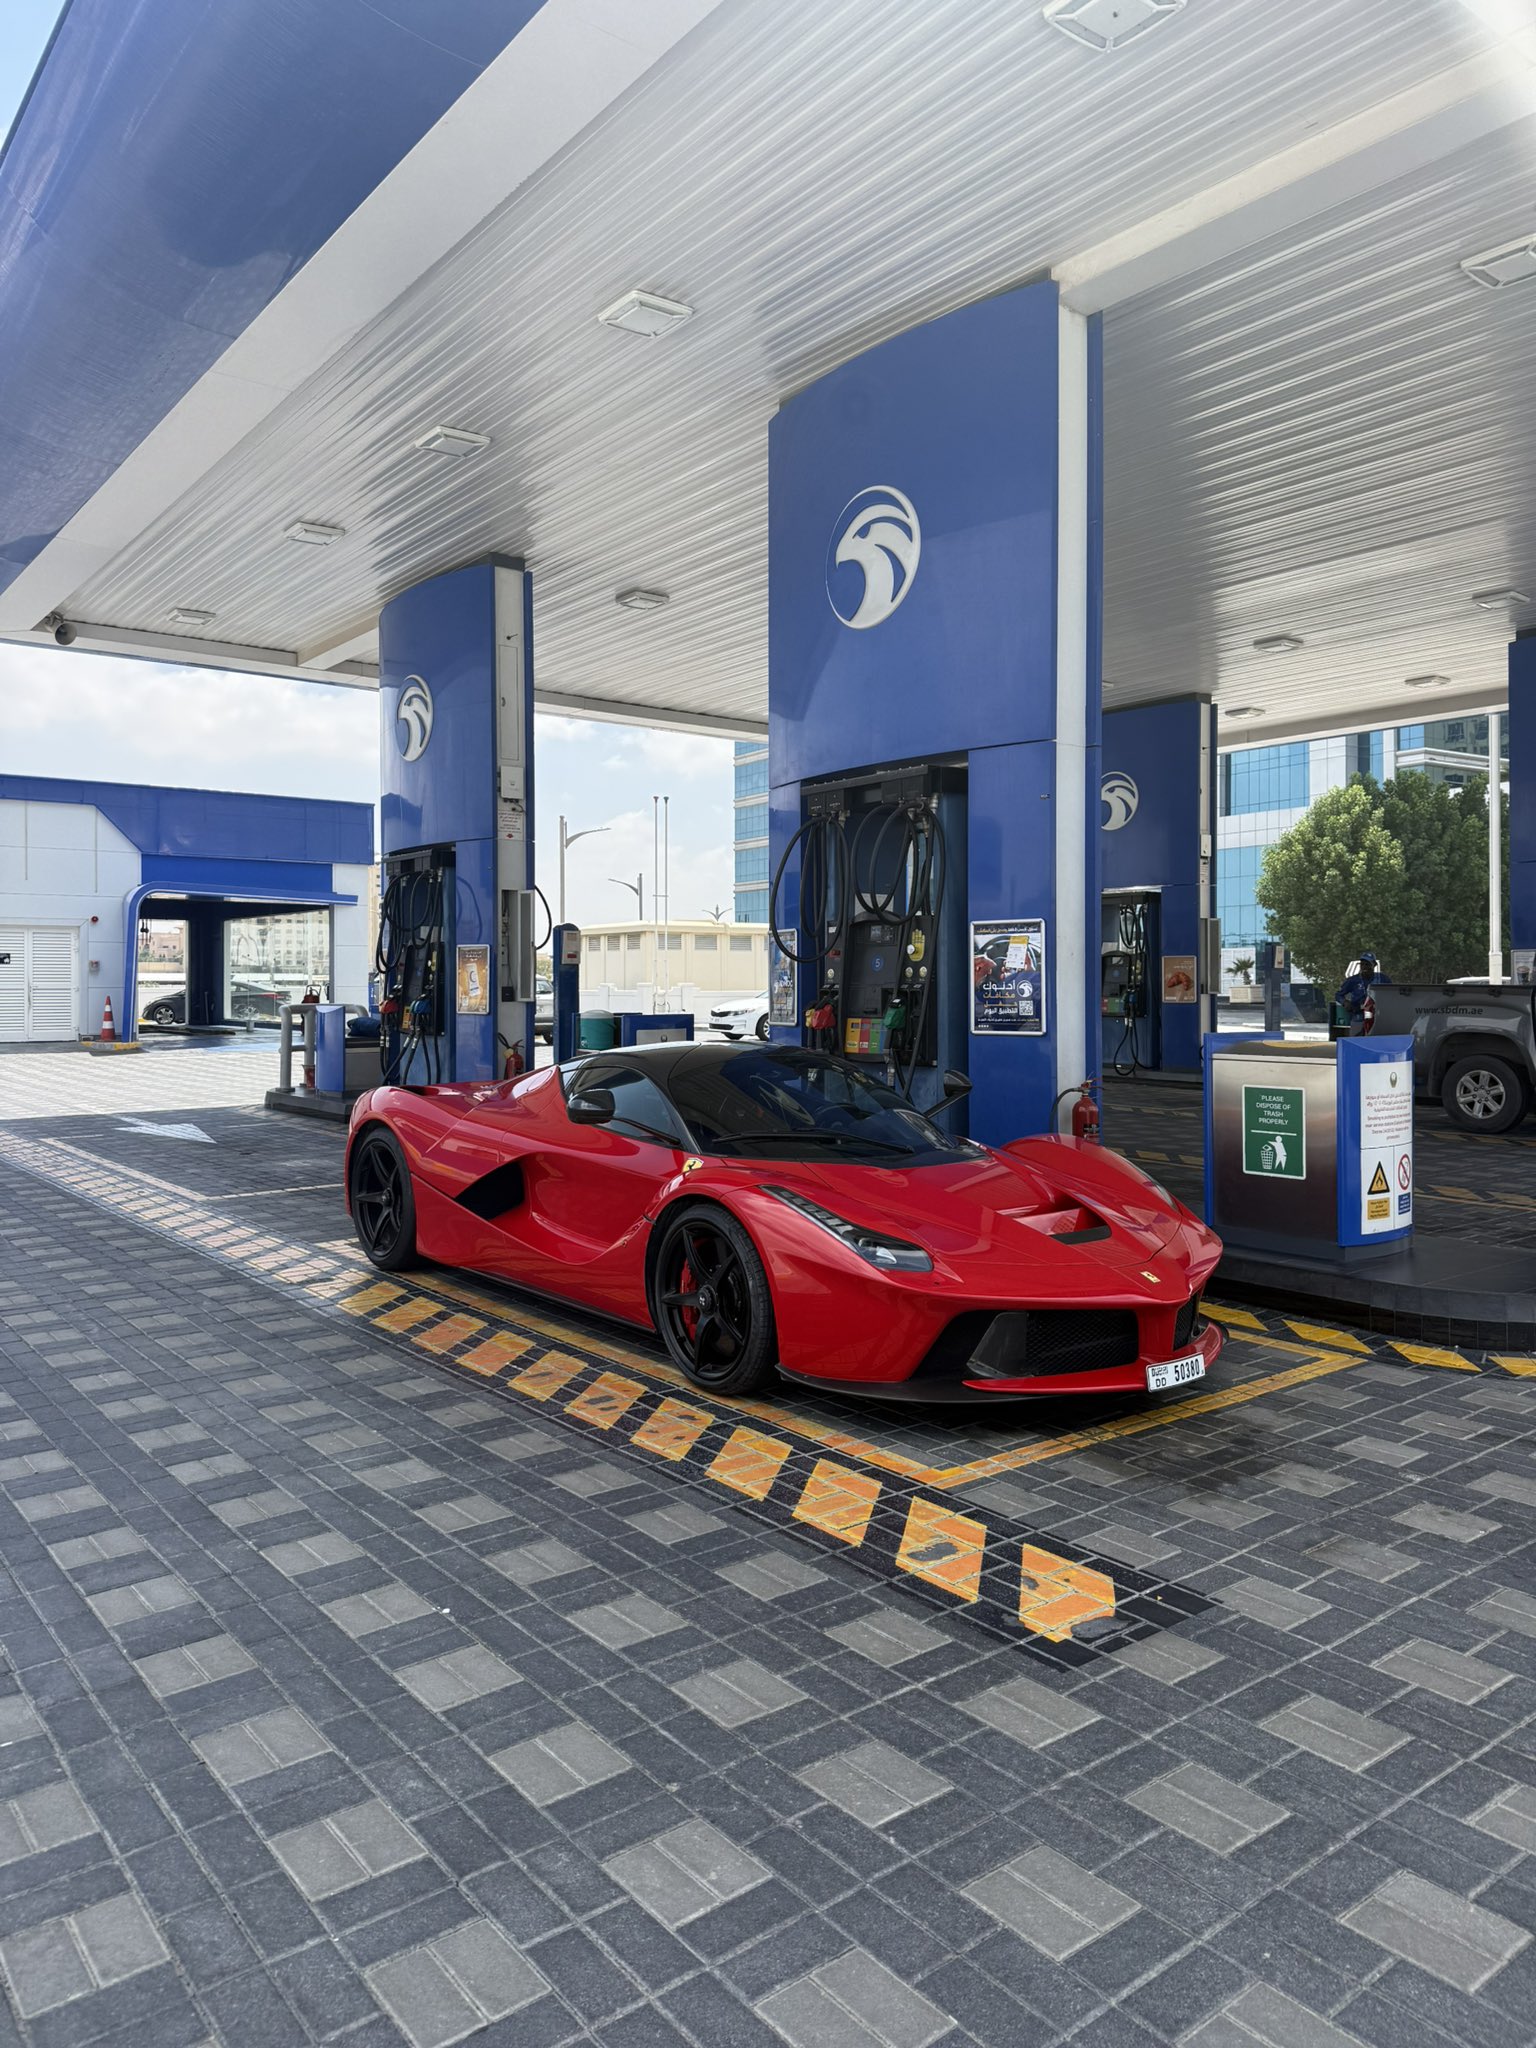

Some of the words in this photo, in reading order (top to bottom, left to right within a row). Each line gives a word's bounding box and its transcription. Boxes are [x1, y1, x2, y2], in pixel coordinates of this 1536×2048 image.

[1415, 1004, 1484, 1015] www.sbdm.ae
[1255, 1102, 1282, 1110] DISPOSE
[1258, 1117, 1289, 1125] PROPERLY
[1174, 1358, 1200, 1381] 50380
[1155, 1377, 1166, 1387] DD
